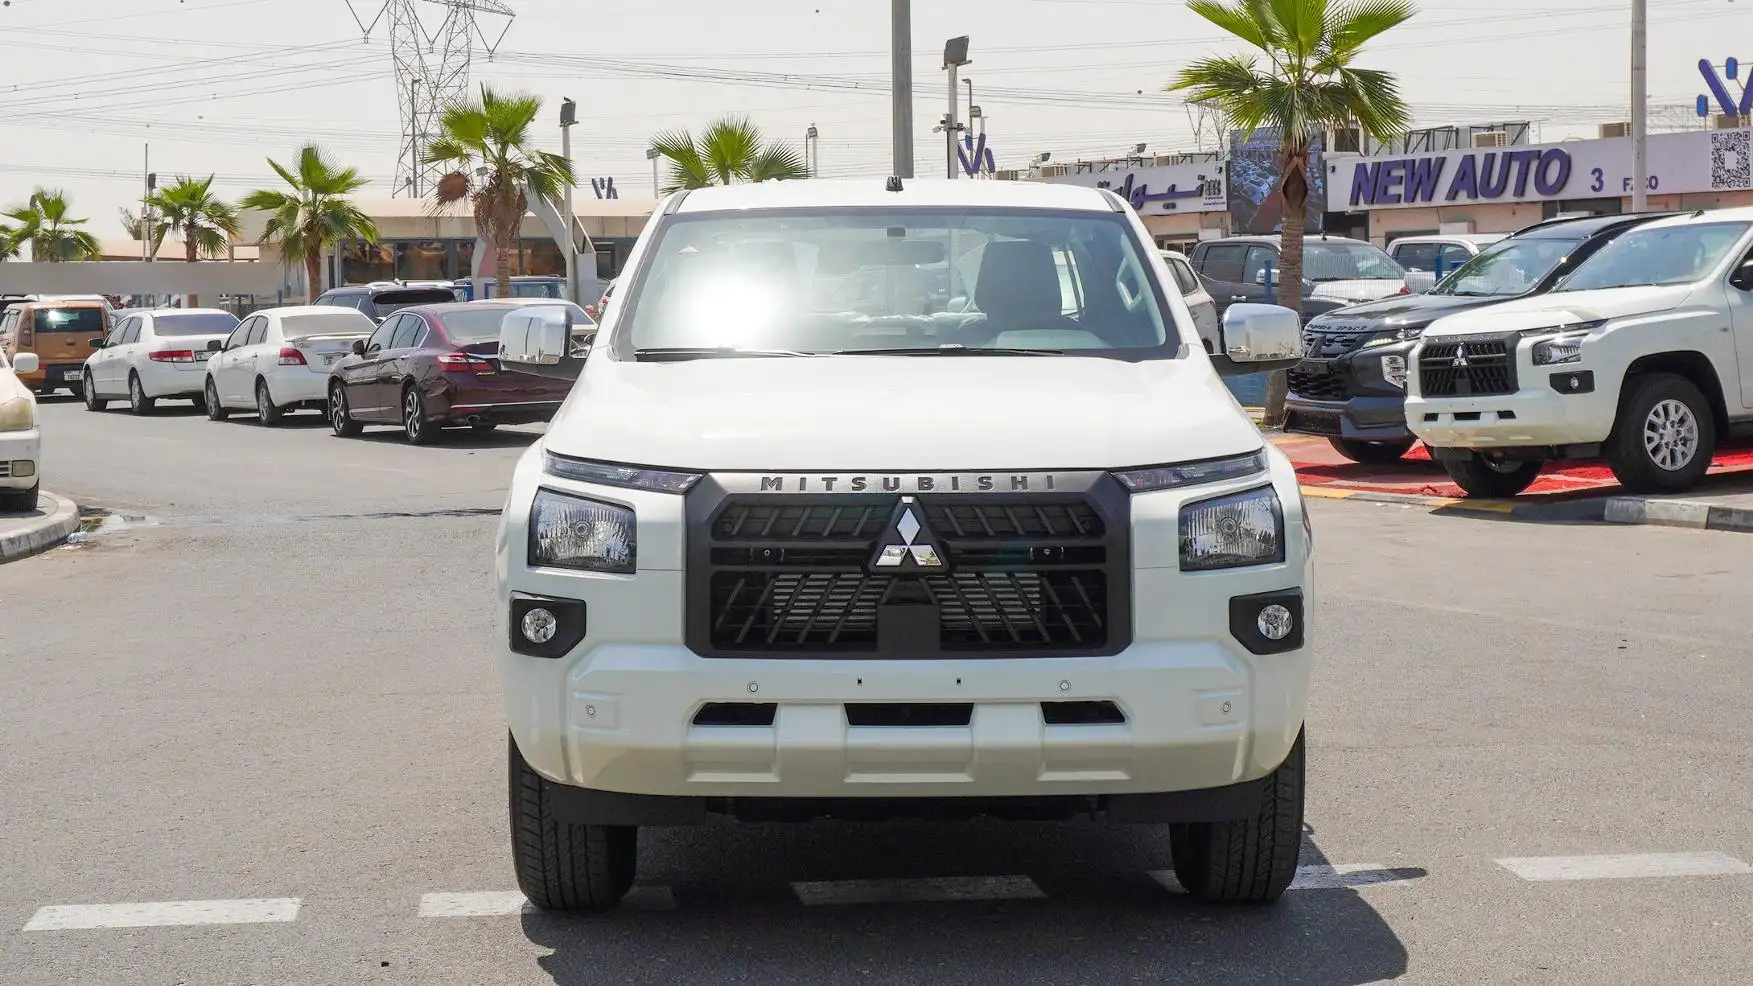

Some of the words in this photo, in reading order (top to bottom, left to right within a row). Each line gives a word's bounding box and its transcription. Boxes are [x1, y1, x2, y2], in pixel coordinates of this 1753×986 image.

[1349, 156, 1446, 206] NEW
[1445, 148, 1572, 201] AUTO
[1590, 167, 1605, 193] 3
[1622, 175, 1659, 193] FO
[760, 473, 1056, 492] MITSUBISHI
